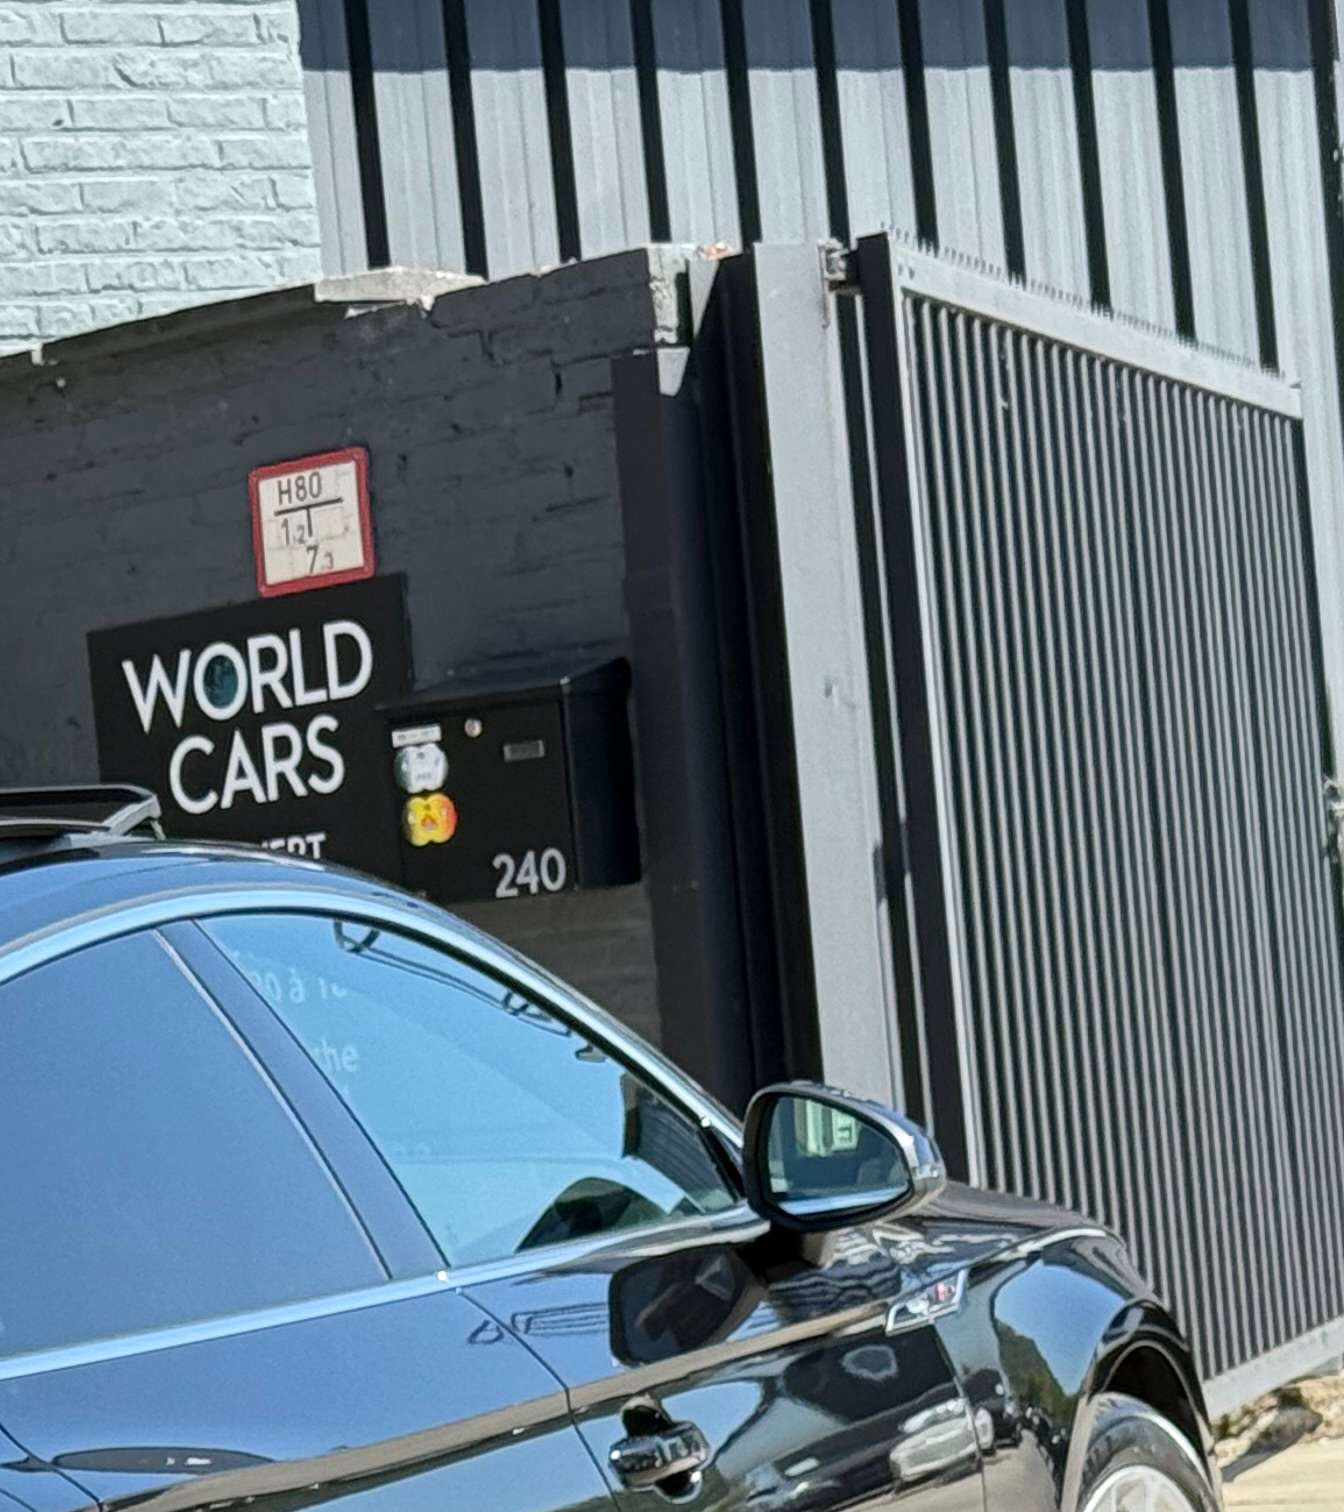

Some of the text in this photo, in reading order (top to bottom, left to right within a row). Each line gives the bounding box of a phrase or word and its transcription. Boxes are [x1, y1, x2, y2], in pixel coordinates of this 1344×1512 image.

[276, 471, 323, 506] H80
[120, 619, 374, 735] WORLD
[168, 713, 346, 806] CARS
[491, 847, 567, 899] 240
